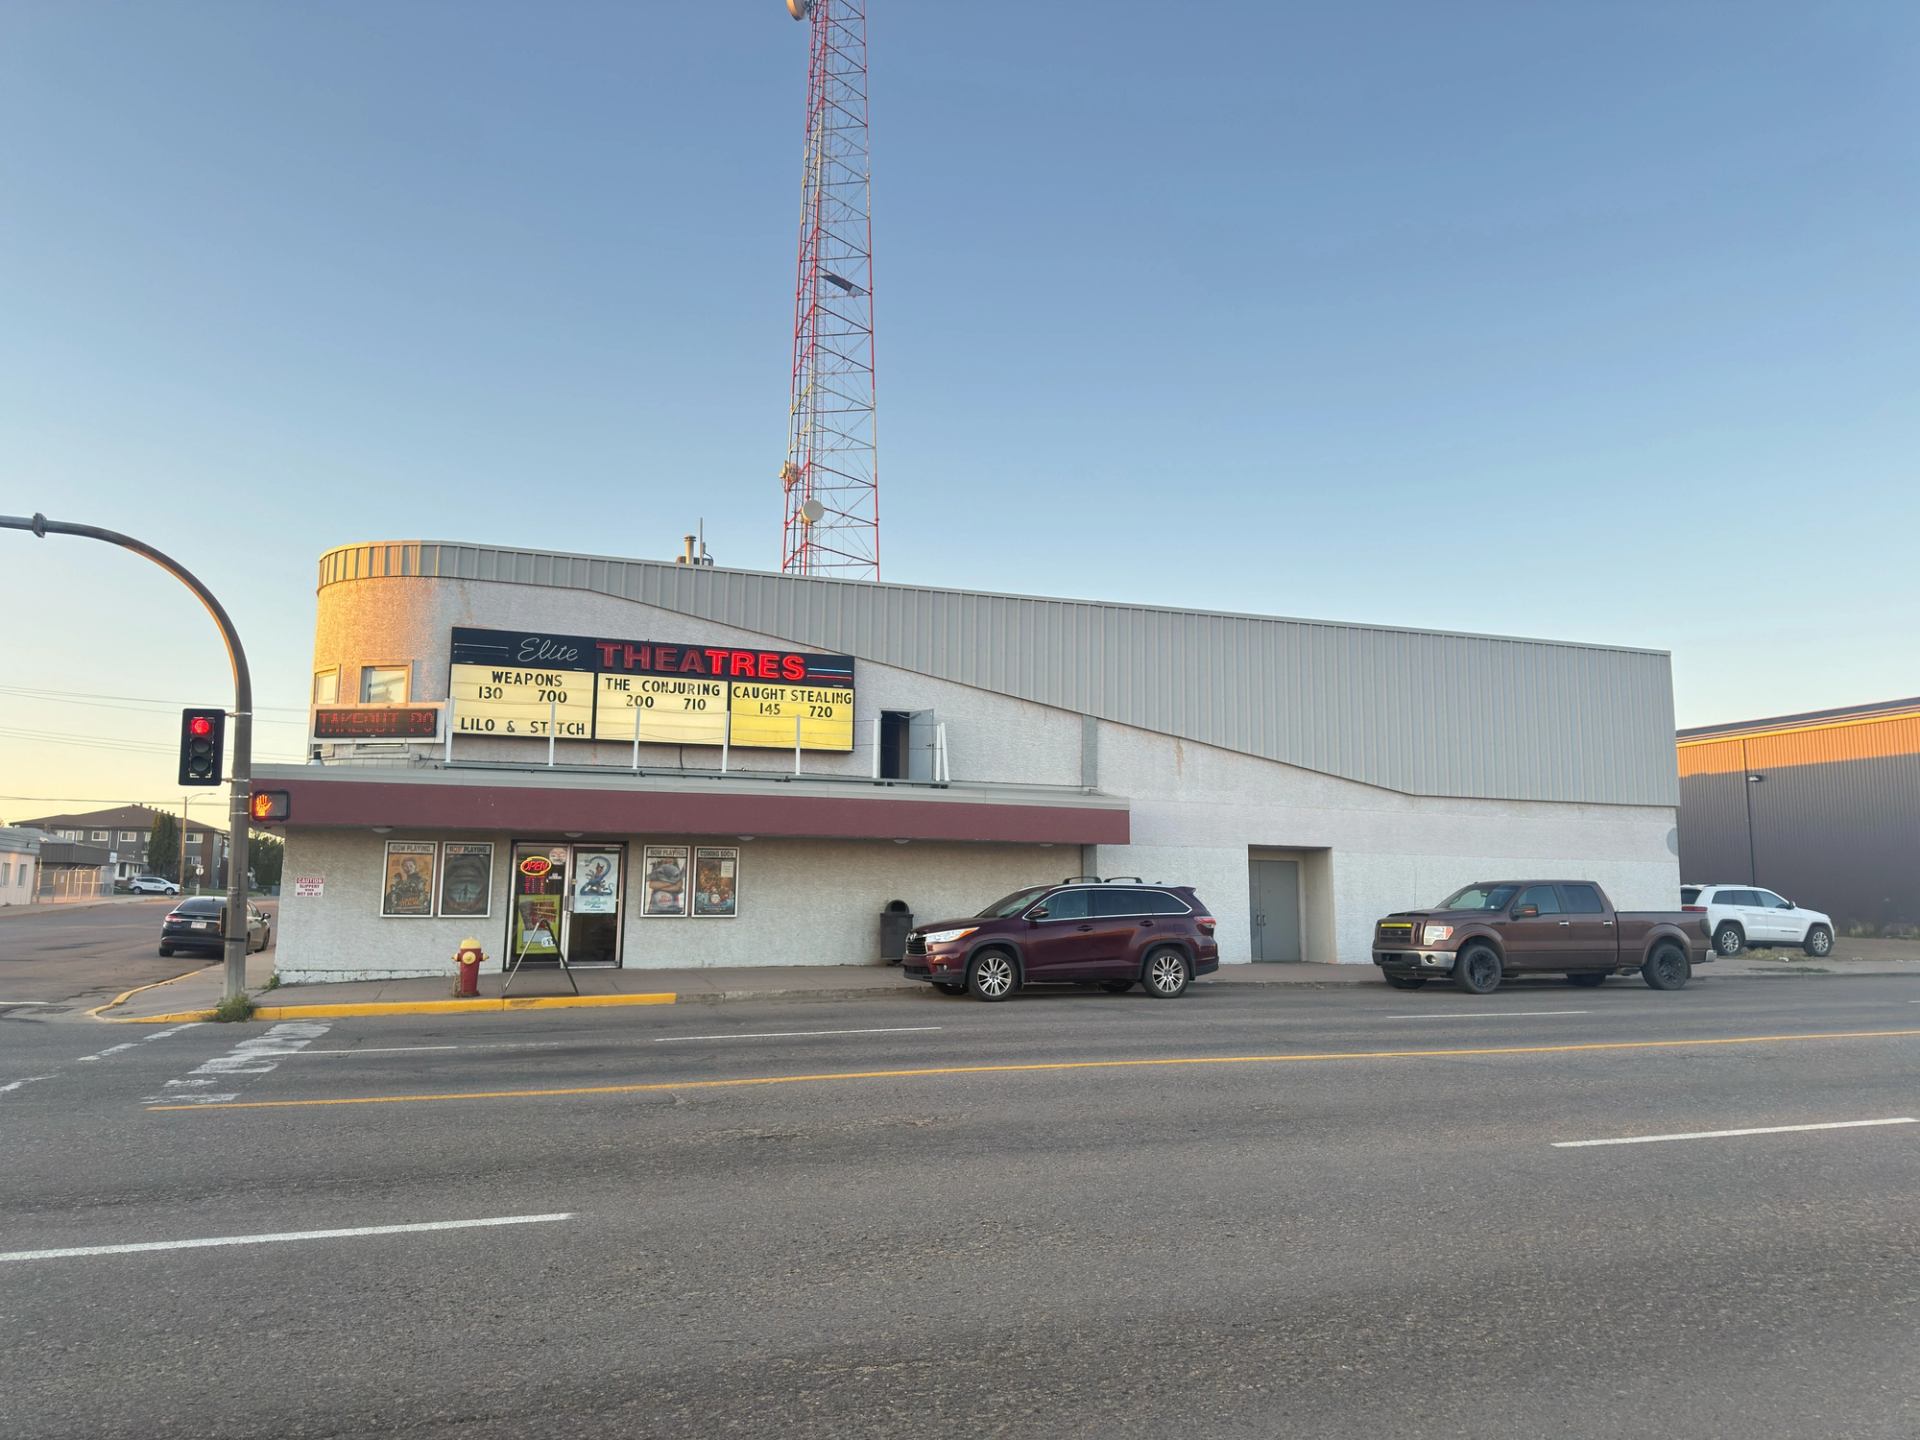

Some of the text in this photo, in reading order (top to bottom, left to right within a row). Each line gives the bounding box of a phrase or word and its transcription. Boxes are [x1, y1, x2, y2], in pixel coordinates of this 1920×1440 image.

[517, 637, 579, 662] Elite
[596, 642, 805, 681] THEATRES
[491, 670, 563, 688] WEAPONS
[605, 677, 720, 697] THE CONJURING
[478, 685, 568, 704] 130 700
[625, 694, 707, 711] 200 710
[732, 686, 852, 705] CAUGHT STEALING
[759, 702, 833, 718] 145 720
[460, 717, 586, 735] LILO & STTCH
[525, 860, 548, 872] OPEN
